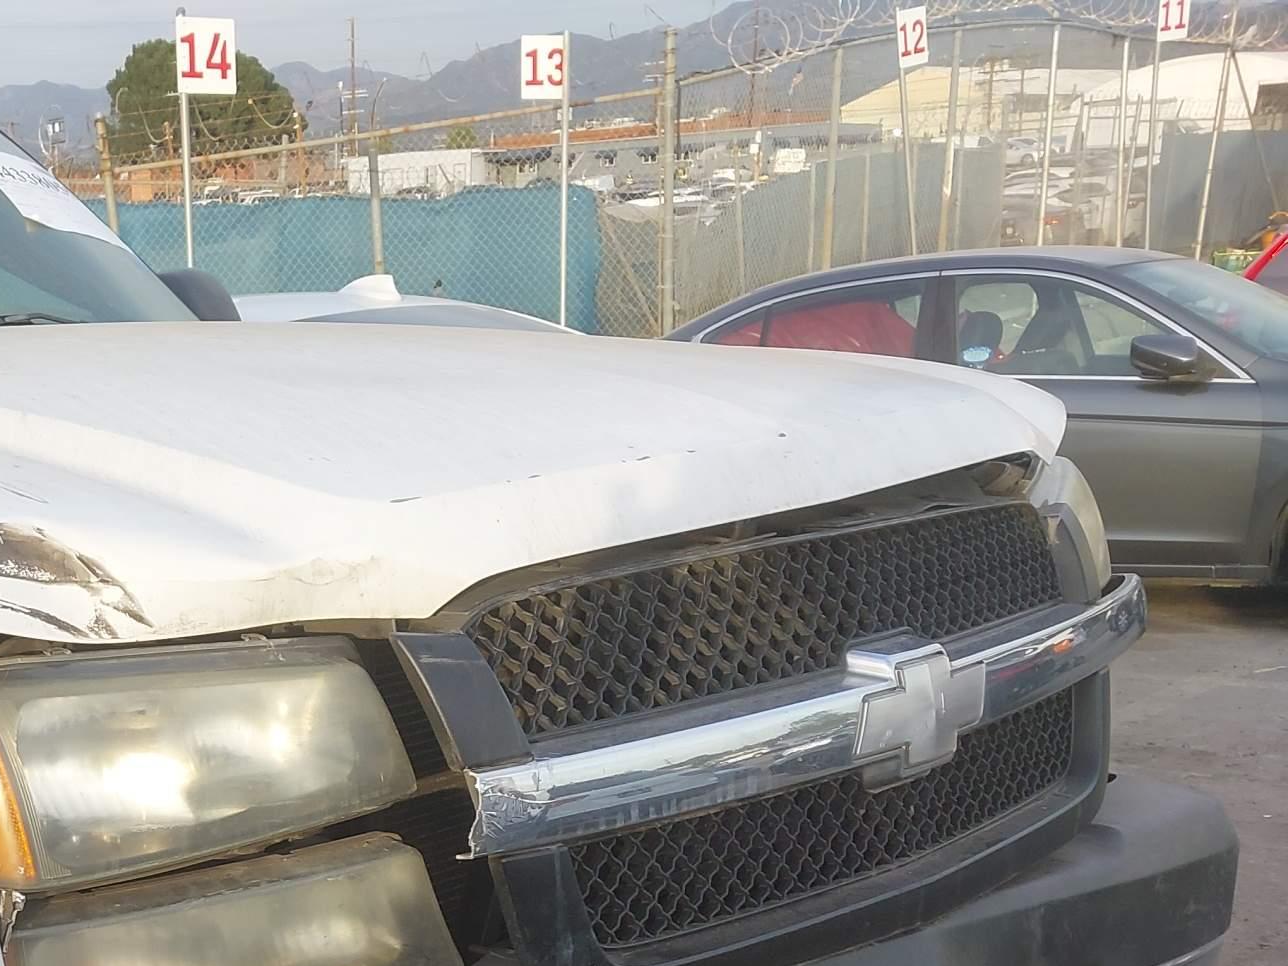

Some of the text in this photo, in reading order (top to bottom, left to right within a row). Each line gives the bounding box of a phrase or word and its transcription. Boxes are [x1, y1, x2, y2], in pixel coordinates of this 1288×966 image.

[1160, 0, 1186, 32] 11
[180, 32, 232, 80] 14
[900, 20, 925, 57] 12
[524, 47, 566, 86] 13
